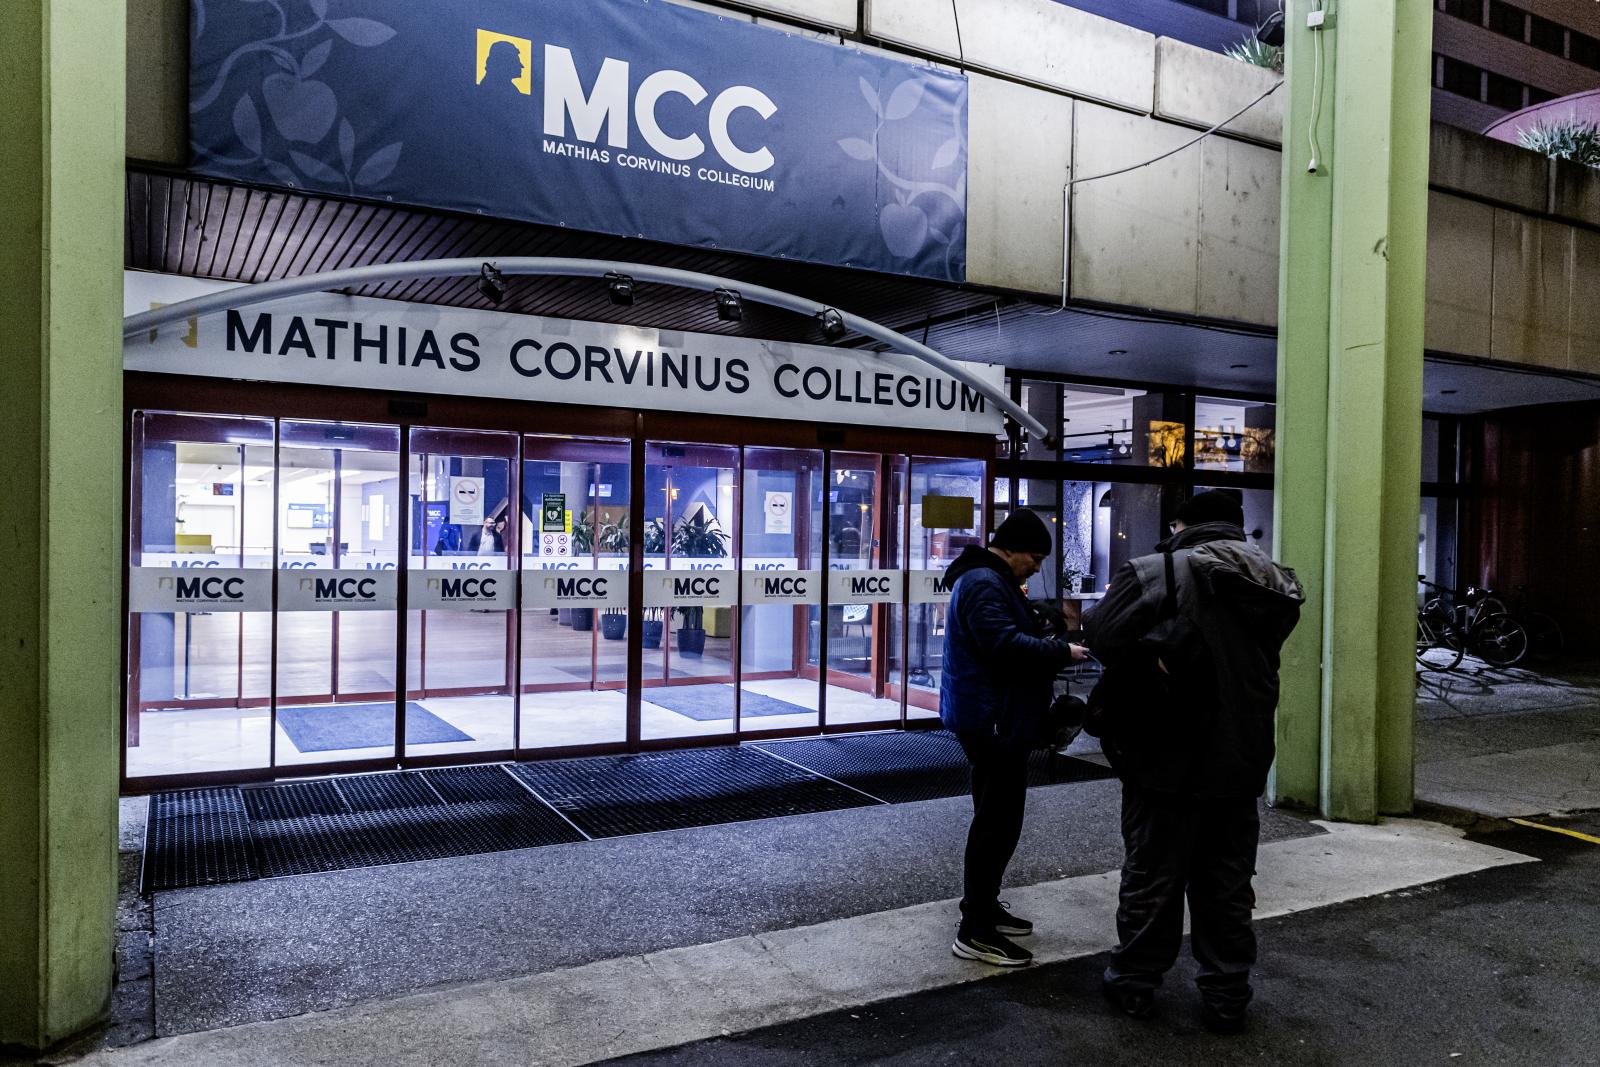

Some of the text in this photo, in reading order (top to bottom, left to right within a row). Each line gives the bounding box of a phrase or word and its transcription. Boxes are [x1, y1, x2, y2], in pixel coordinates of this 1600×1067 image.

[543, 43, 778, 174] MCC
[542, 139, 775, 193] MATHIAS CORVINUS COLLEGIUM
[226, 309, 986, 413] MATHIAS CORVINUS COLLEGIUM
[176, 576, 245, 599] MCC
[315, 578, 377, 599] MCC
[441, 578, 497, 598] MCC
[556, 577, 608, 597] MCC
[674, 577, 720, 596] MCC
[764, 577, 807, 595] MCC
[851, 576, 891, 593] MCC
